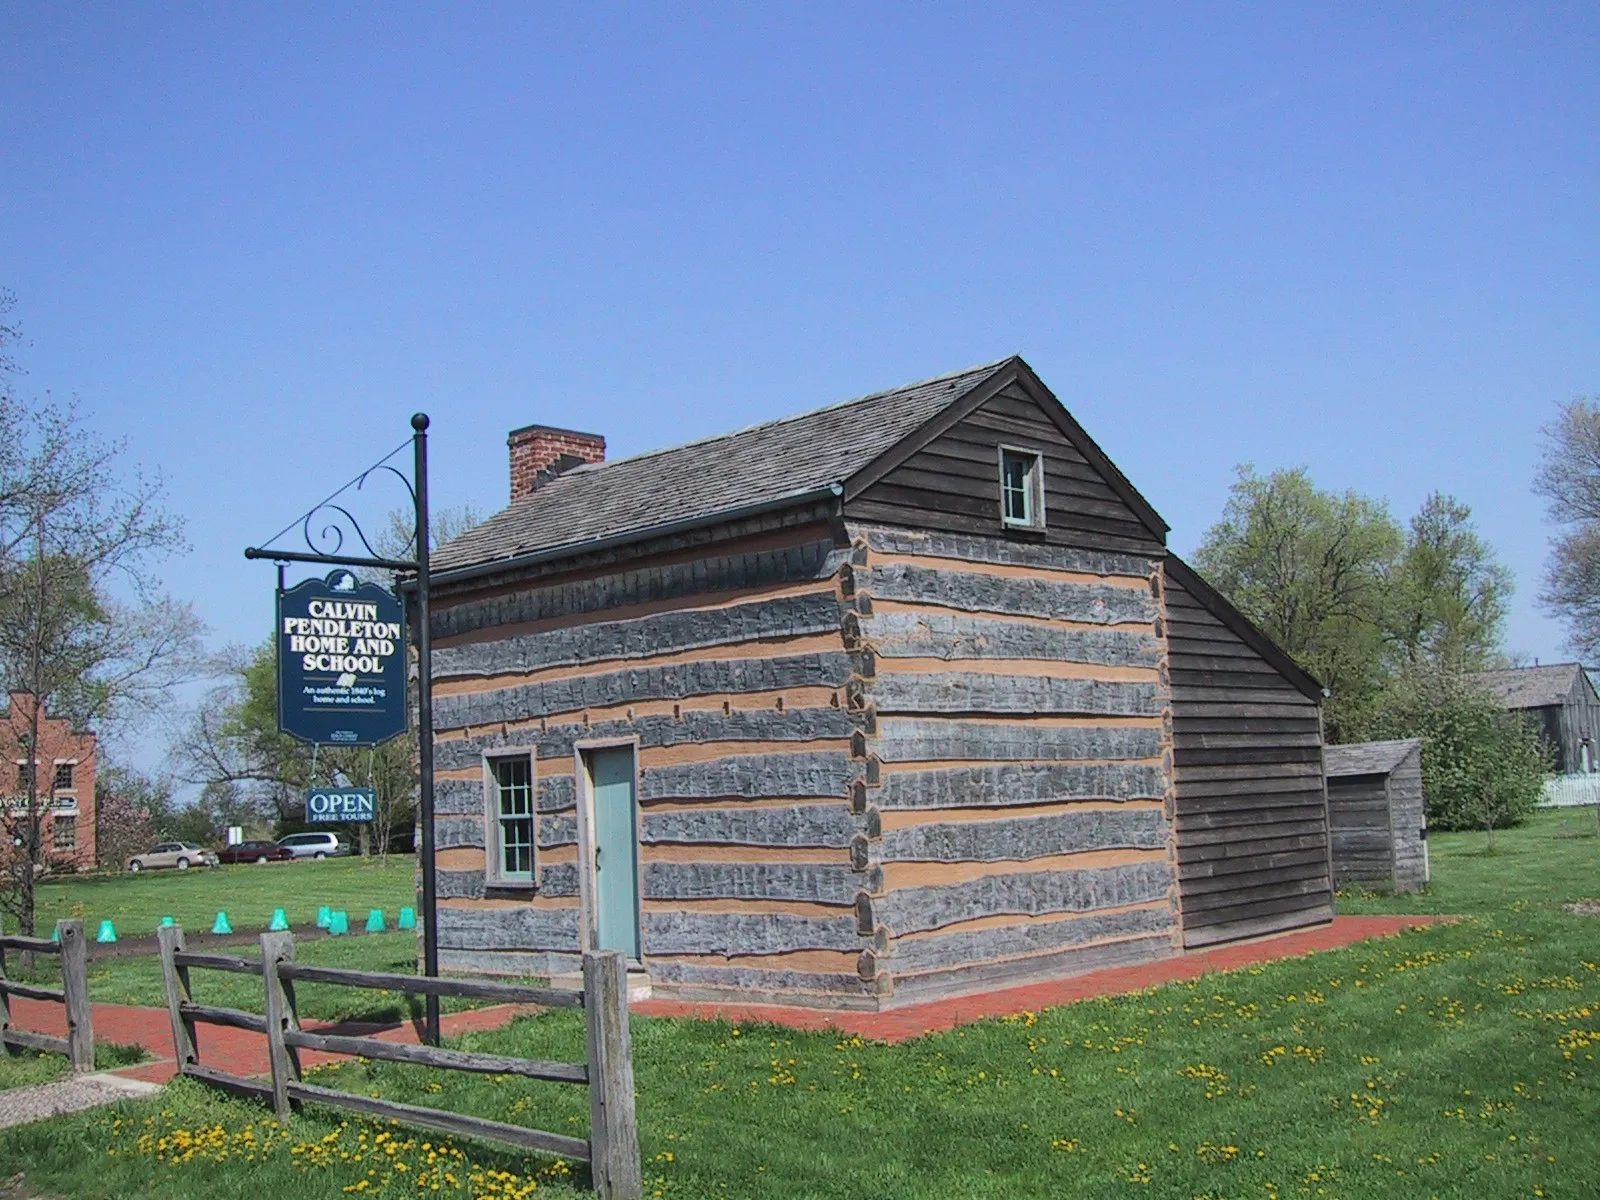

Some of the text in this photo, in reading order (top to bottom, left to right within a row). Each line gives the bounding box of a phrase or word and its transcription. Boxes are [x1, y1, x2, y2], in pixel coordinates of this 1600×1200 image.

[308, 601, 377, 620] CALVIN
[284, 617, 401, 639] PENDLETON
[290, 635, 395, 656] HOME AND
[302, 654, 384, 673] SCHOOL
[302, 686, 312, 694] An
[315, 686, 350, 695] authentic
[312, 694, 335, 703] home
[335, 695, 350, 704] and
[310, 793, 374, 813] OPEN
[312, 812, 373, 821] FREE TOURS
